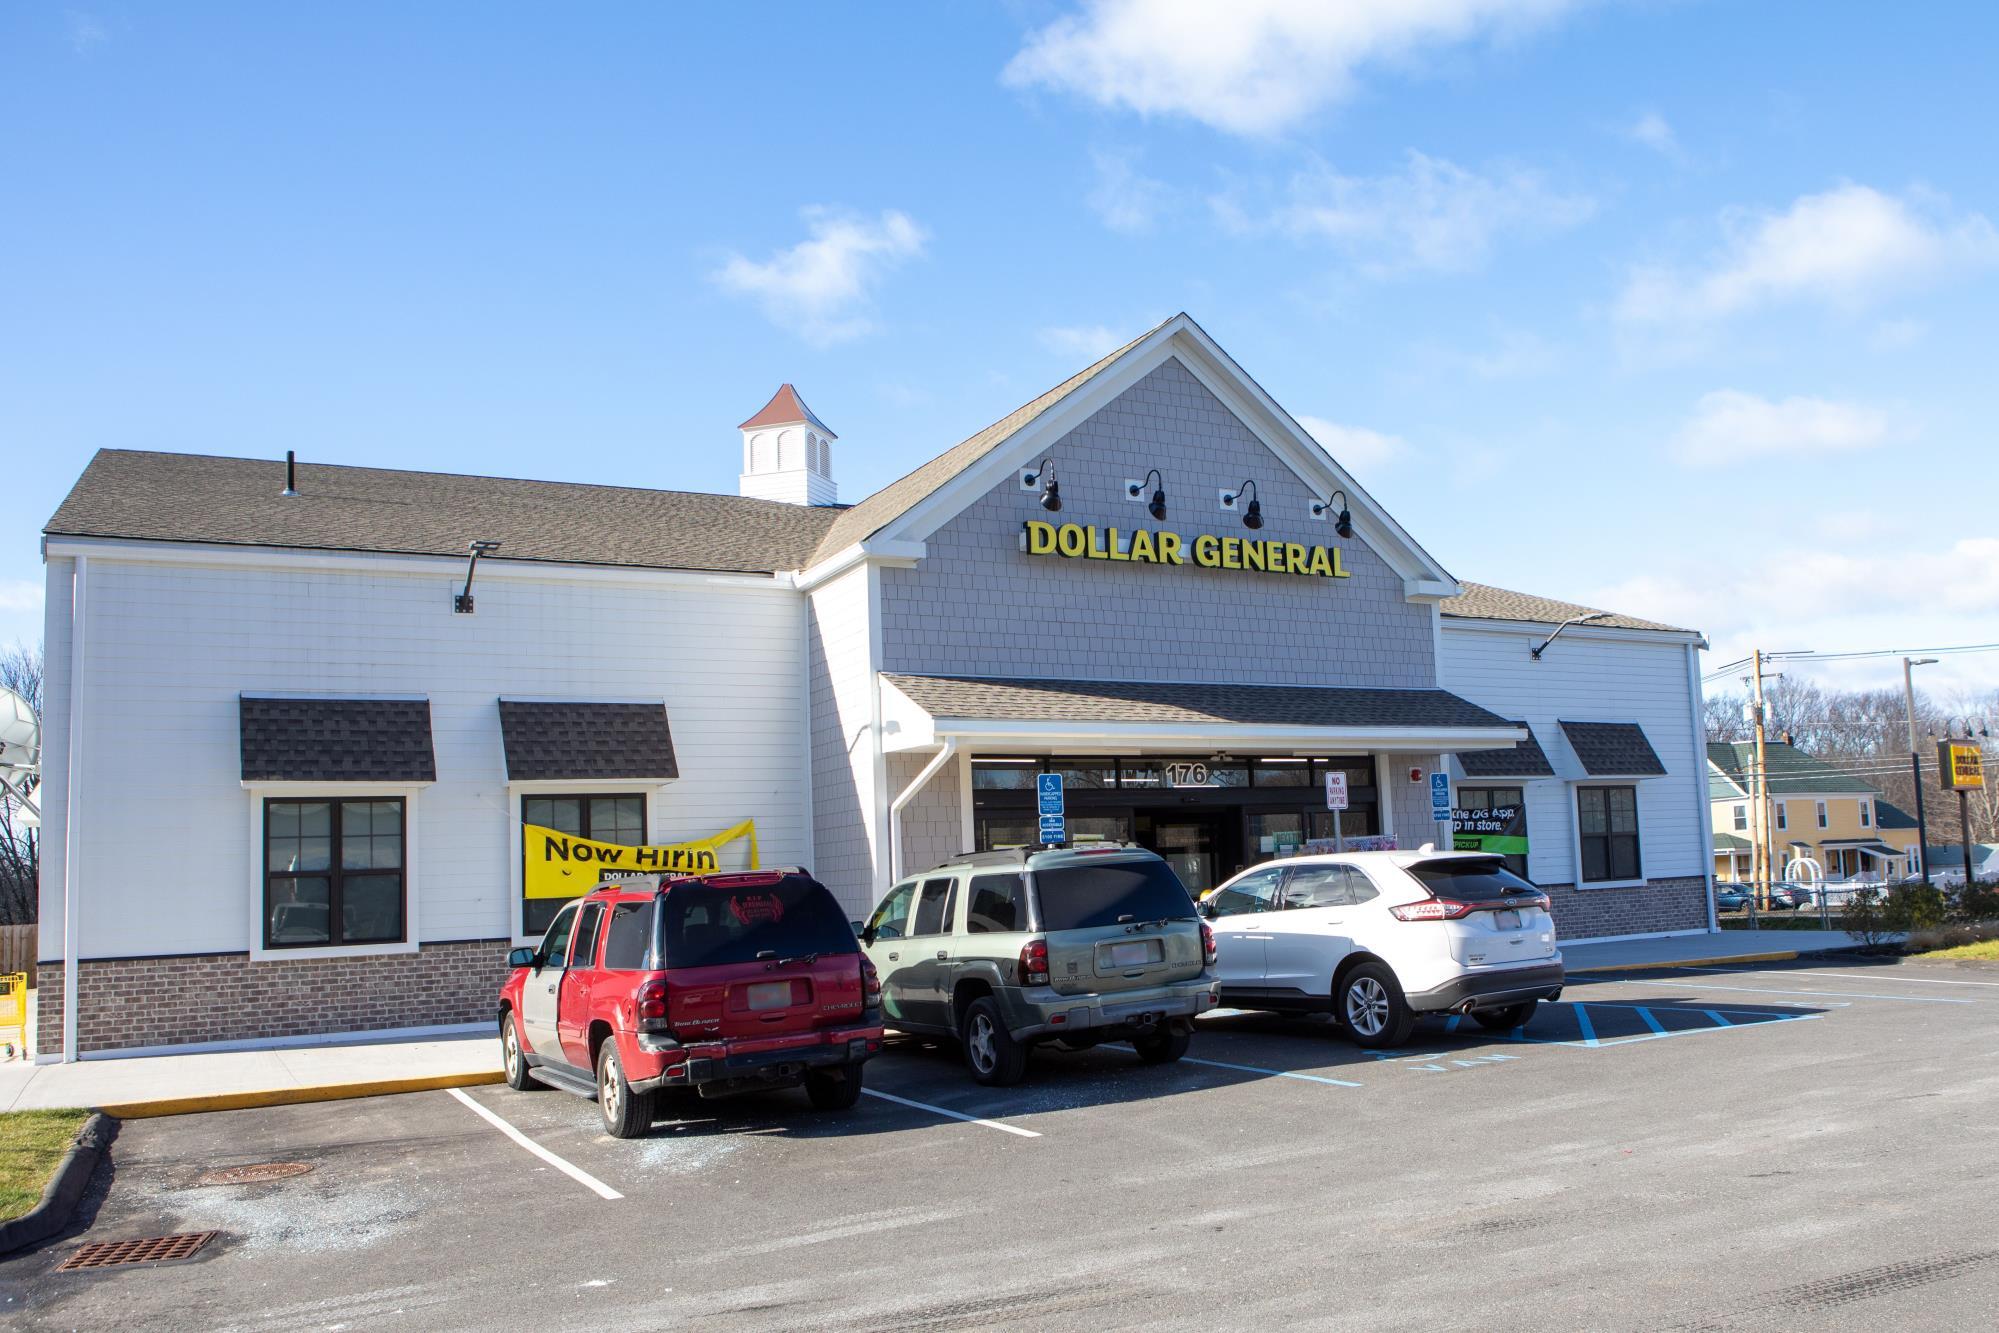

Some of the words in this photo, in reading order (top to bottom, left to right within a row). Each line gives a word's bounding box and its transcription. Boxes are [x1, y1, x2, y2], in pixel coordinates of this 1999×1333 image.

[1025, 520, 1184, 566] DOLLAR
[1190, 534, 1351, 578] GENERAL
[1165, 763, 1207, 785] 176
[1331, 776, 1341, 786] NO
[1476, 820, 1502, 832] store.
[545, 835, 623, 863] Now
[635, 847, 716, 870] Hirin
